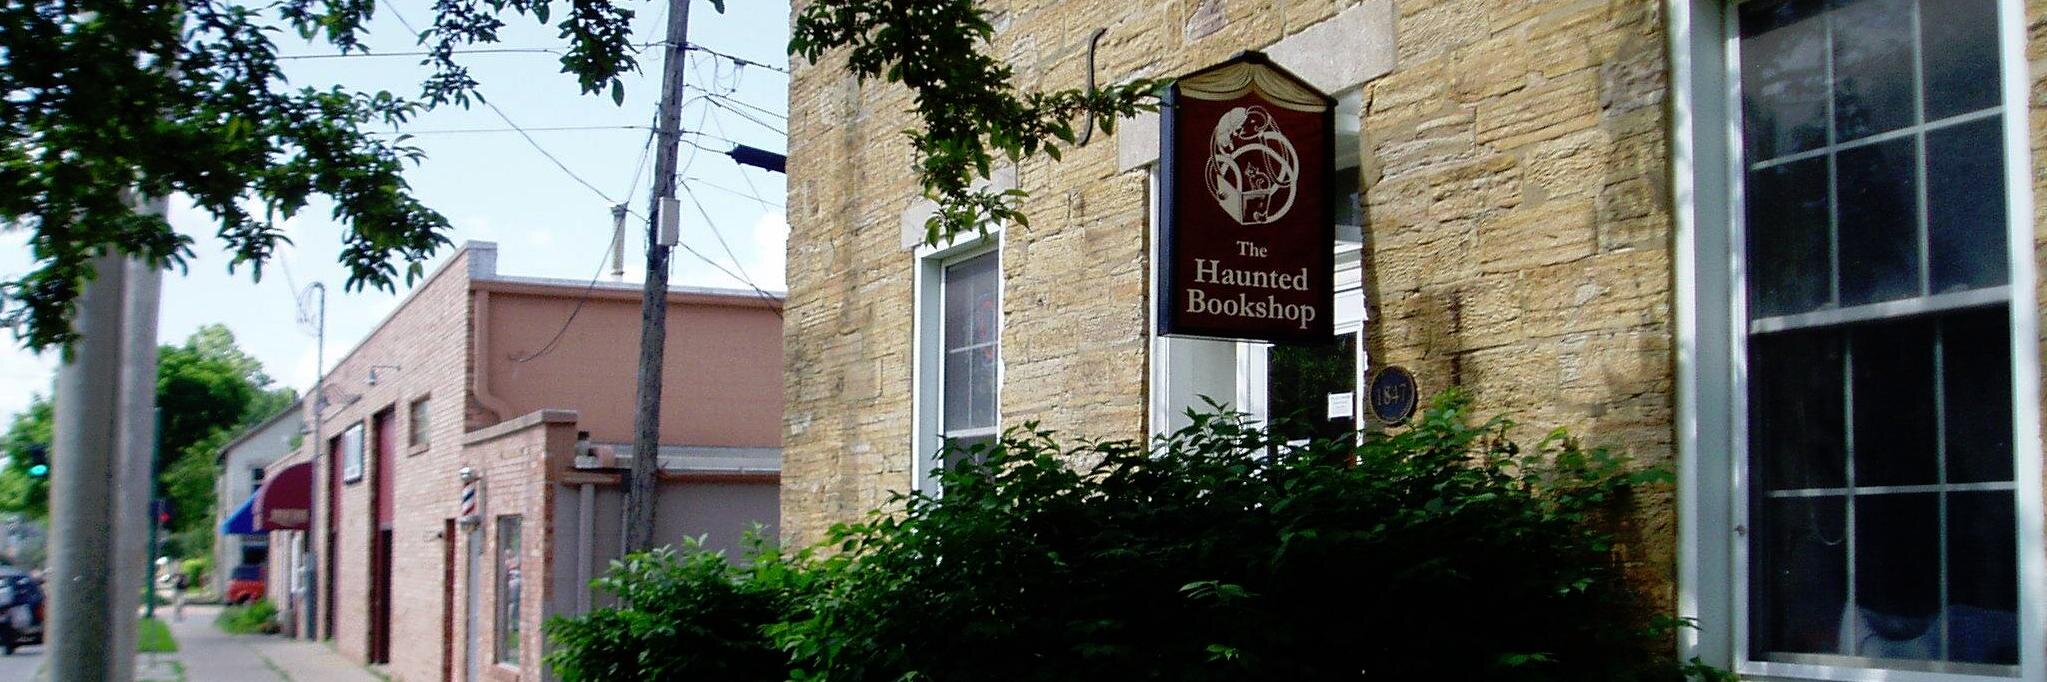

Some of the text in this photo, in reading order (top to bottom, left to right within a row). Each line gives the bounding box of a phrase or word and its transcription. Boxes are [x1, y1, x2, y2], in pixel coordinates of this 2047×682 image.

[1236, 240, 1268, 258] The
[1194, 258, 1309, 291] Haunted
[1186, 288, 1316, 329] Bookshop
[1376, 383, 1407, 406] 1847
